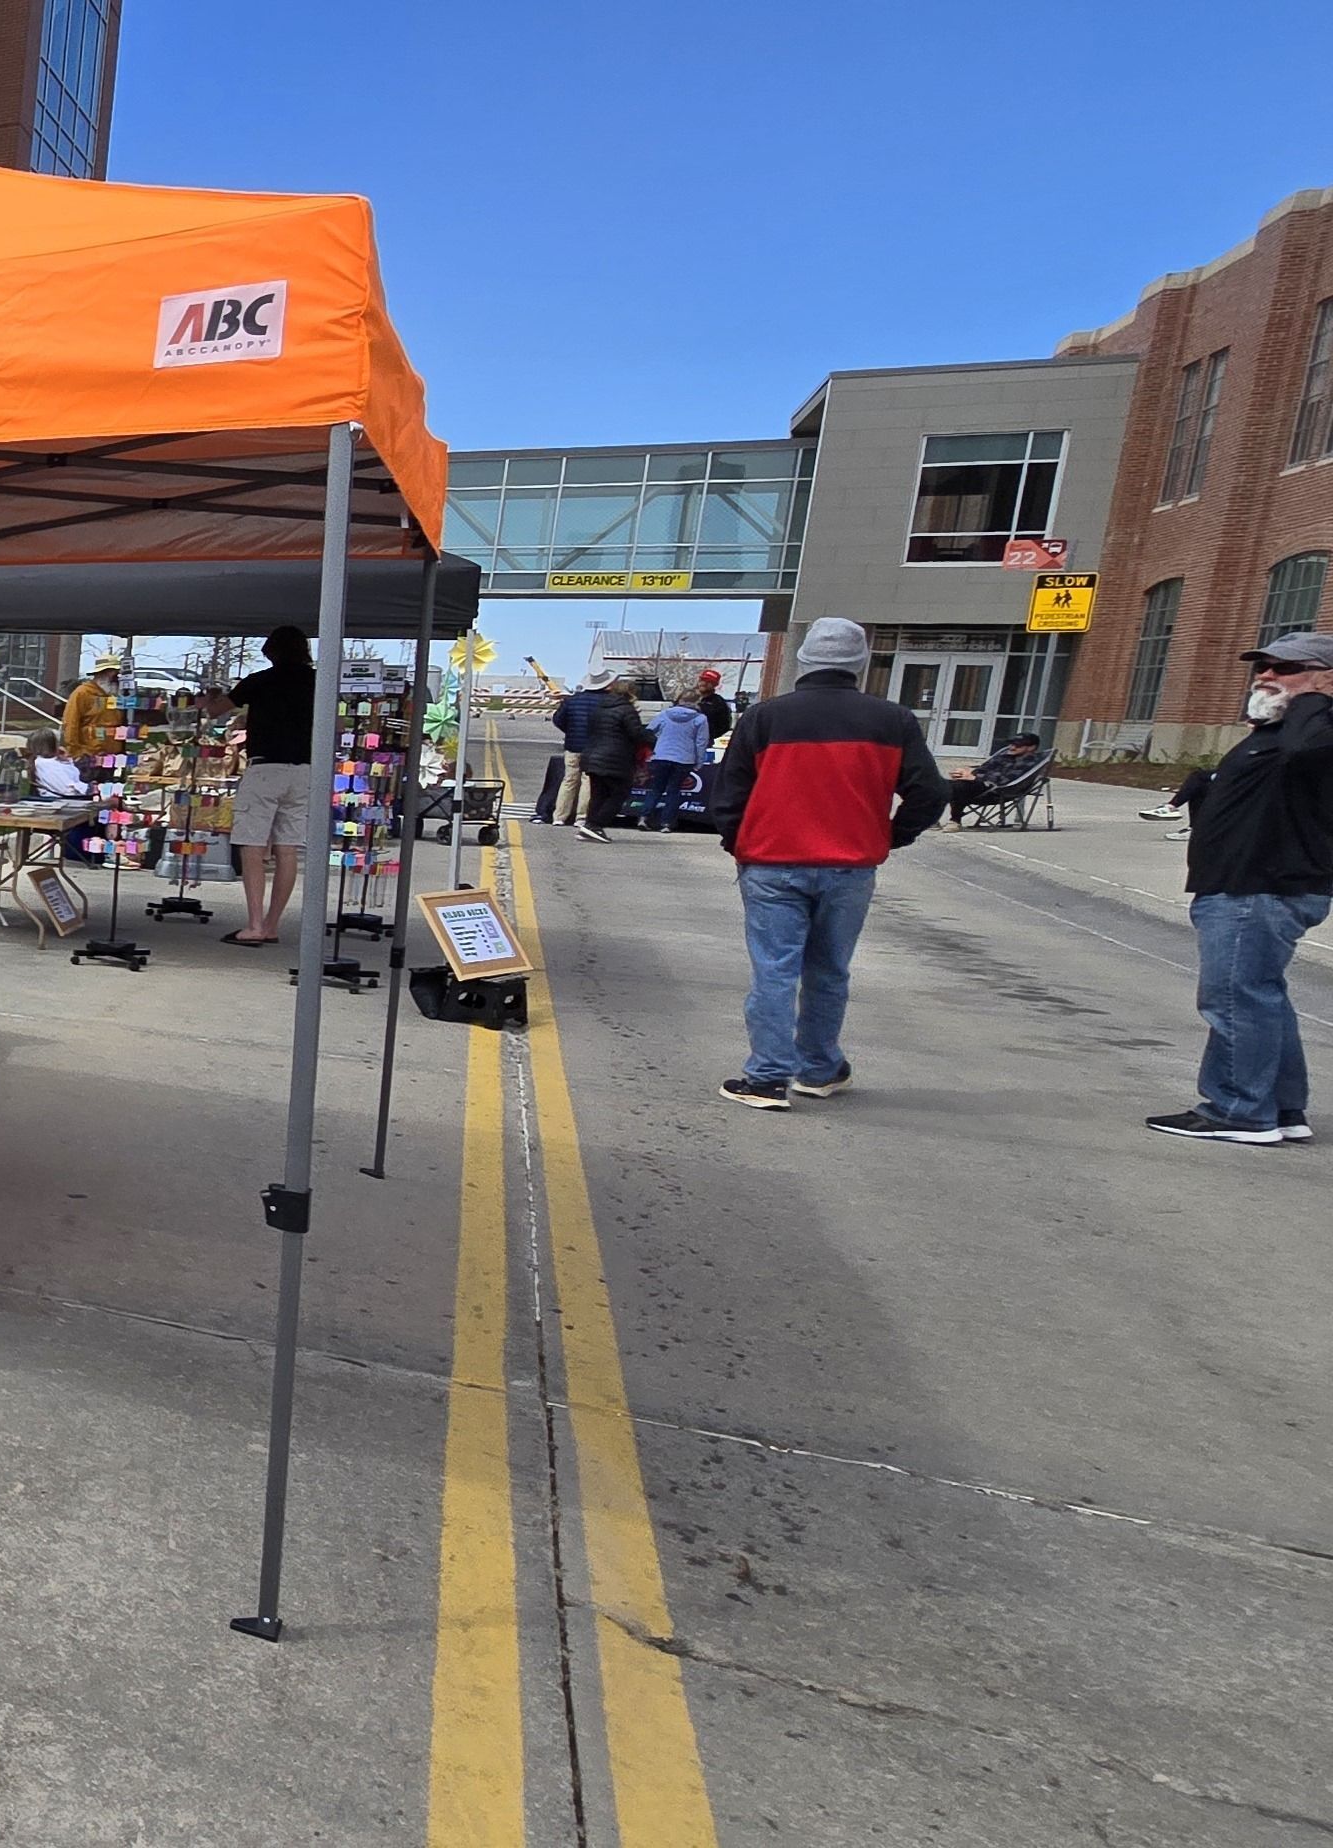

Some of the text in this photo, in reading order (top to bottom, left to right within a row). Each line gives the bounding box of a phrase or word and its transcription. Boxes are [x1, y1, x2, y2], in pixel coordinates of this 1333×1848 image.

[168, 293, 275, 345] ABC
[164, 339, 267, 356] ABCCANOPY
[1006, 551, 1037, 565] 22
[551, 575, 626, 586] CLEARANCE
[1044, 576, 1089, 587] SLOW
